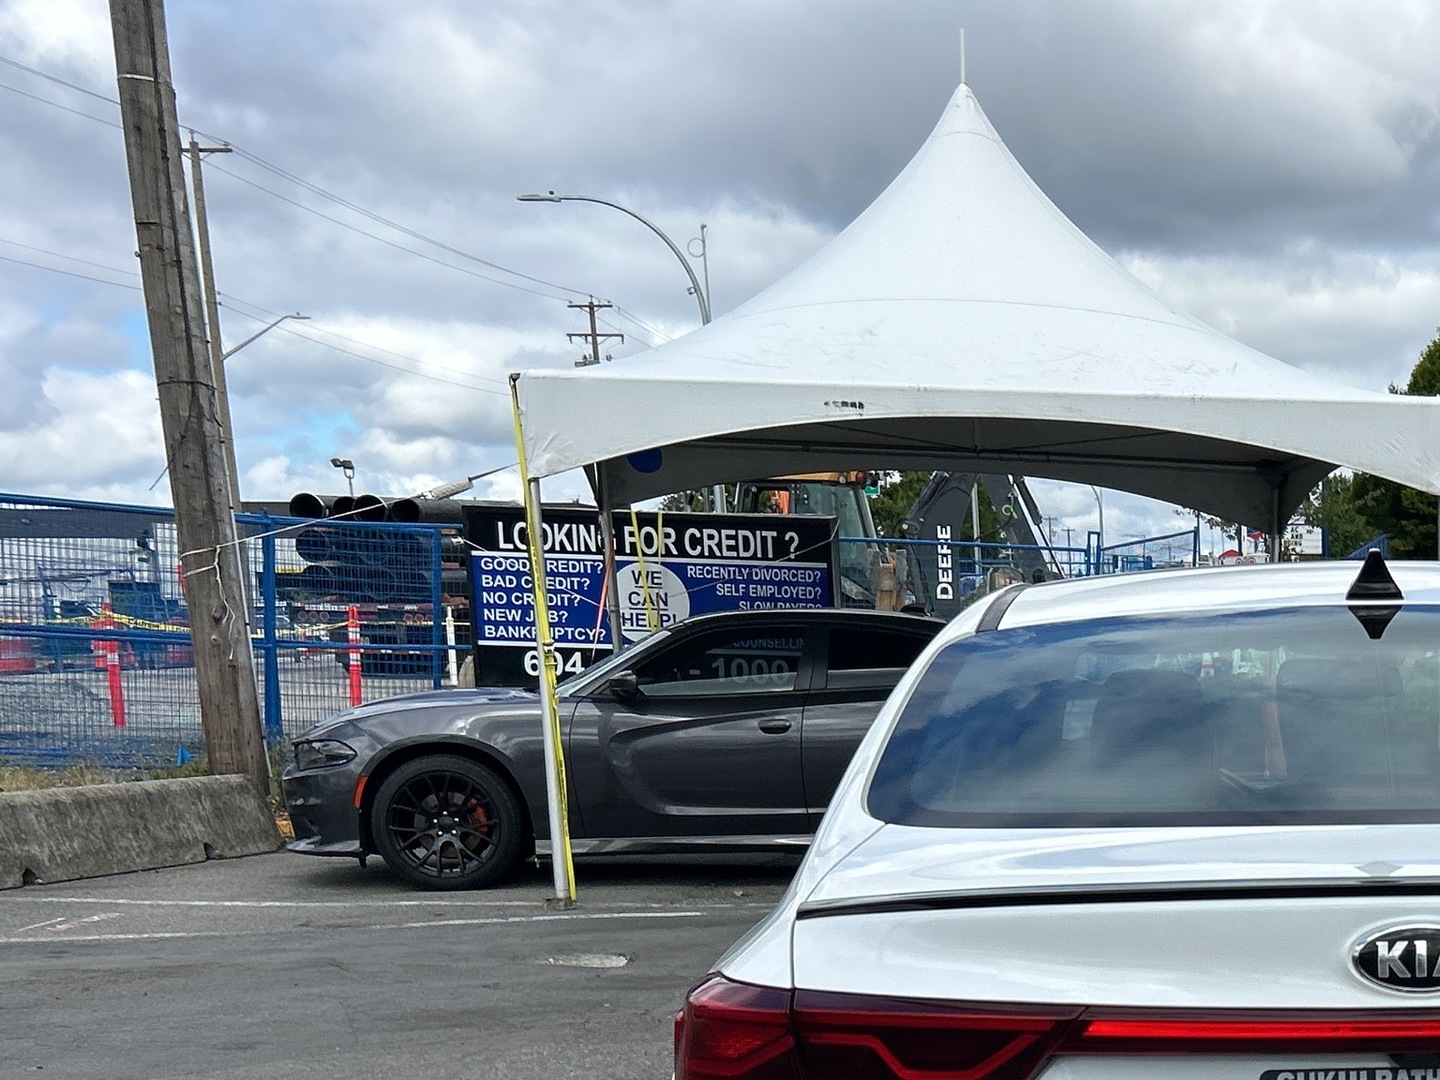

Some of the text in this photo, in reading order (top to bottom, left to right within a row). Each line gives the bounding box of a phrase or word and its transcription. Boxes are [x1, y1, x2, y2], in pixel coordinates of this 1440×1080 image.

[624, 526, 678, 556] FOR
[684, 528, 777, 559] CREDIT
[481, 557, 604, 574] GOOD REDIT?
[936, 525, 954, 600] DEERE
[482, 574, 591, 590] BAD CEDIT?
[631, 570, 662, 585] WE
[687, 565, 821, 583] RECENTLY DIVORCED?
[482, 591, 581, 606] NO CRDIT?
[628, 592, 668, 607] CAN
[716, 584, 822, 599] SELF EMPLOYED?
[483, 609, 569, 623] NEW JB?
[484, 625, 607, 641] BANKPTCY?
